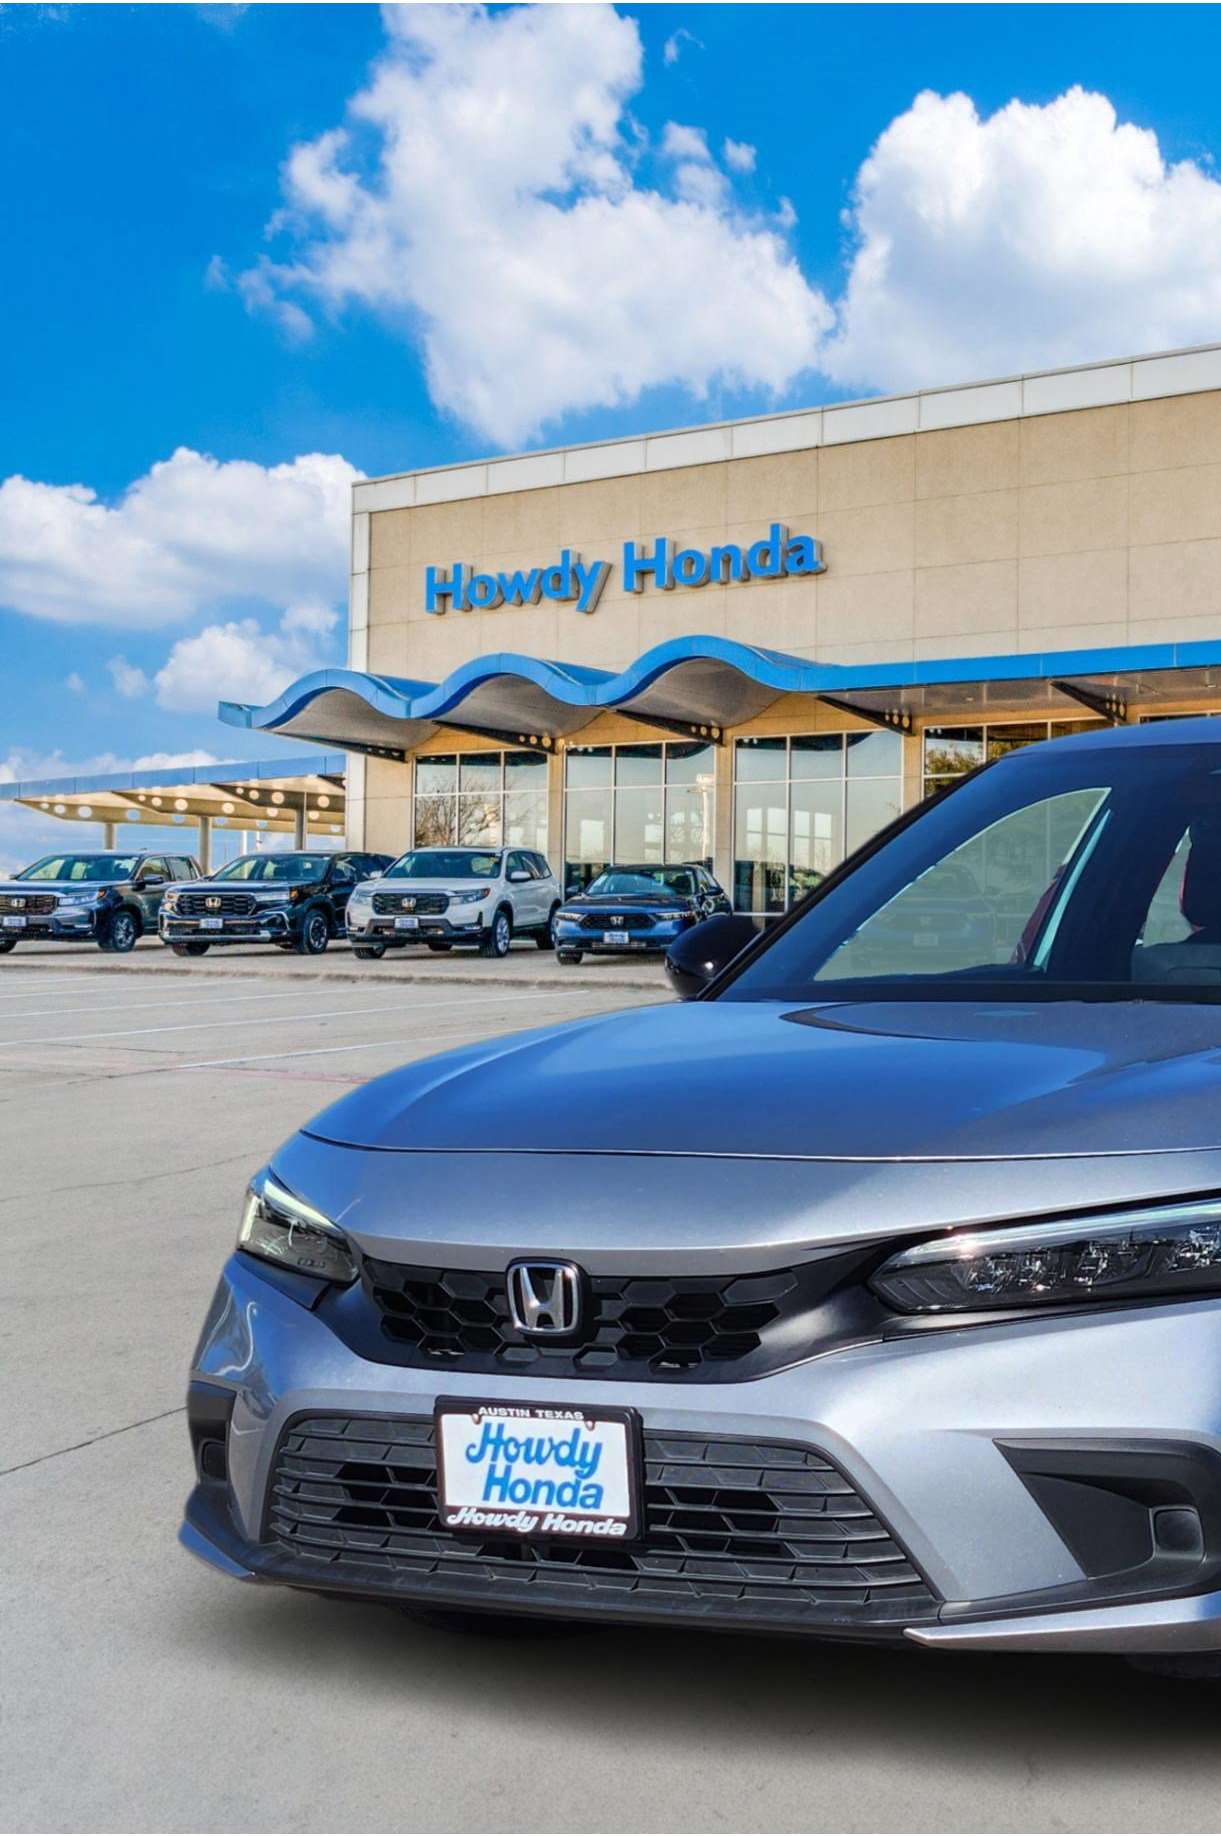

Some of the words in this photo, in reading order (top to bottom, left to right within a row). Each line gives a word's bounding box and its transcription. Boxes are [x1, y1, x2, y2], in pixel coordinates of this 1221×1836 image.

[425, 548, 612, 614] Howdy
[623, 522, 827, 594] Honda
[478, 1406, 530, 1418] AUSTIN
[535, 1409, 585, 1421] TEXAS
[465, 1422, 603, 1480] Howdy
[482, 1463, 604, 1510] Honda
[447, 1506, 539, 1533] Howdy
[540, 1512, 627, 1536] Honda
